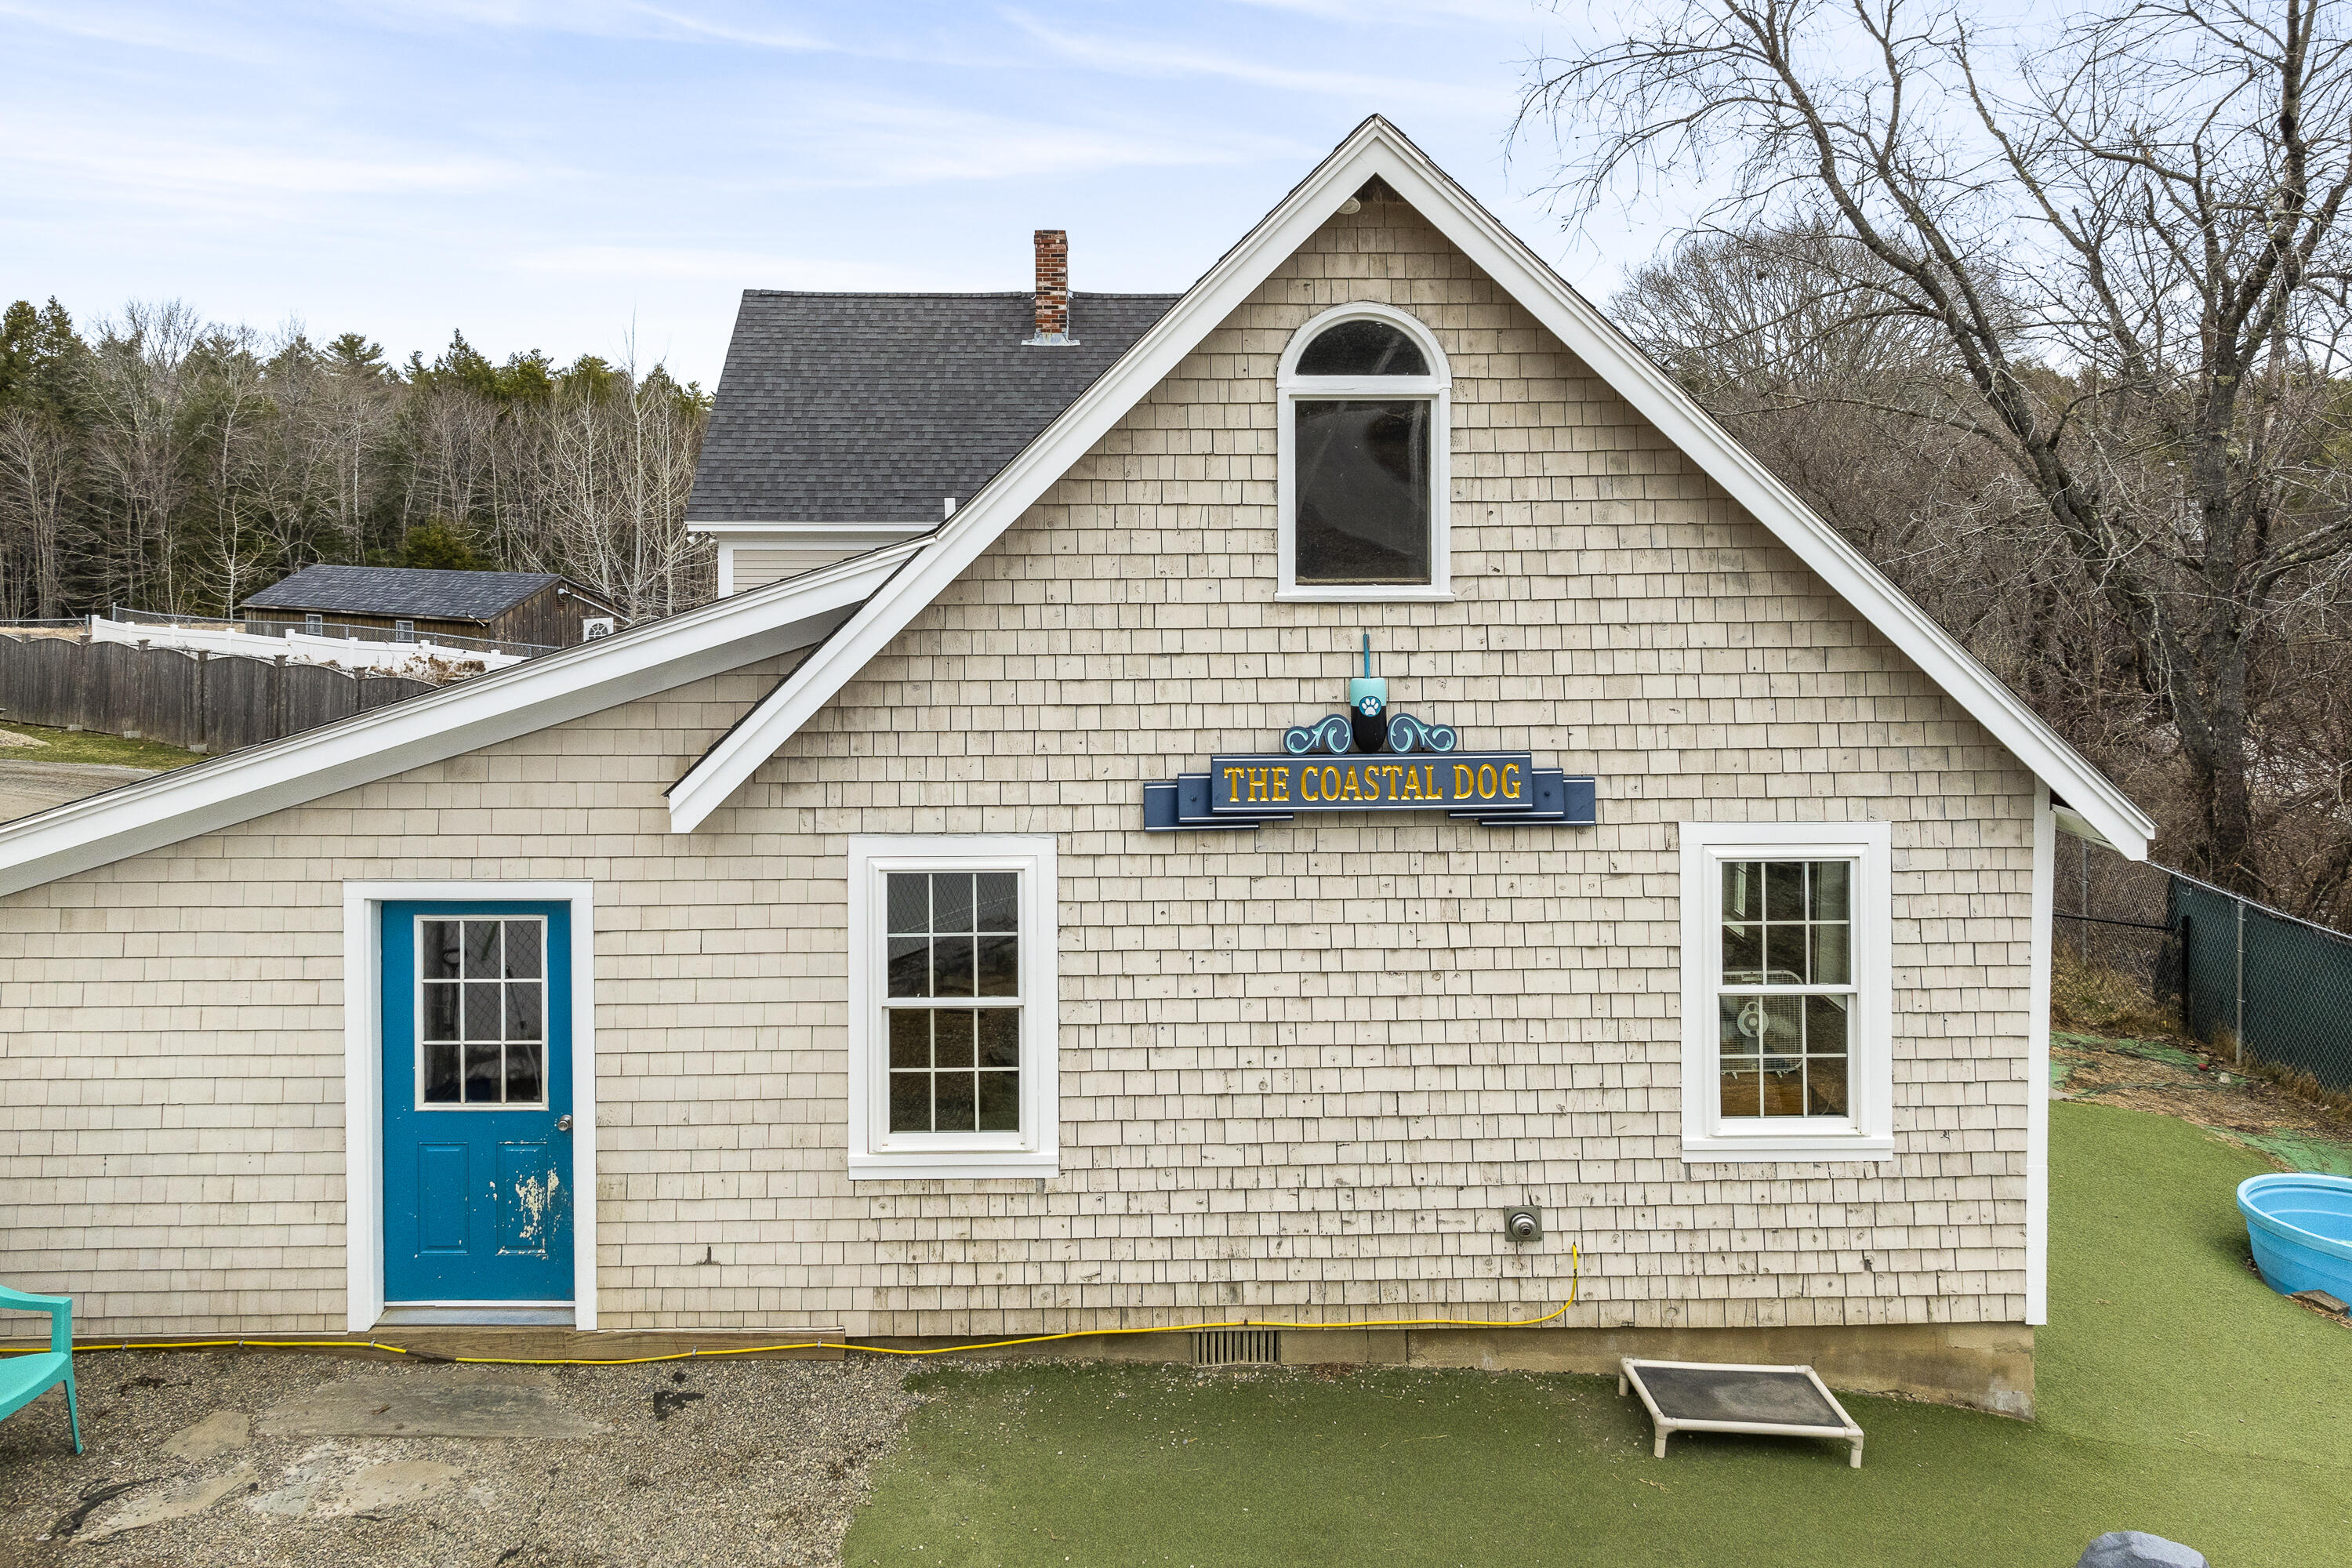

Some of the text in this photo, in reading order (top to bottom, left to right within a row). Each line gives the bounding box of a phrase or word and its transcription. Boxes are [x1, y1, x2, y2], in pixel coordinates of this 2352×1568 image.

[1224, 763, 1522, 802] THE COASTAL DOG
